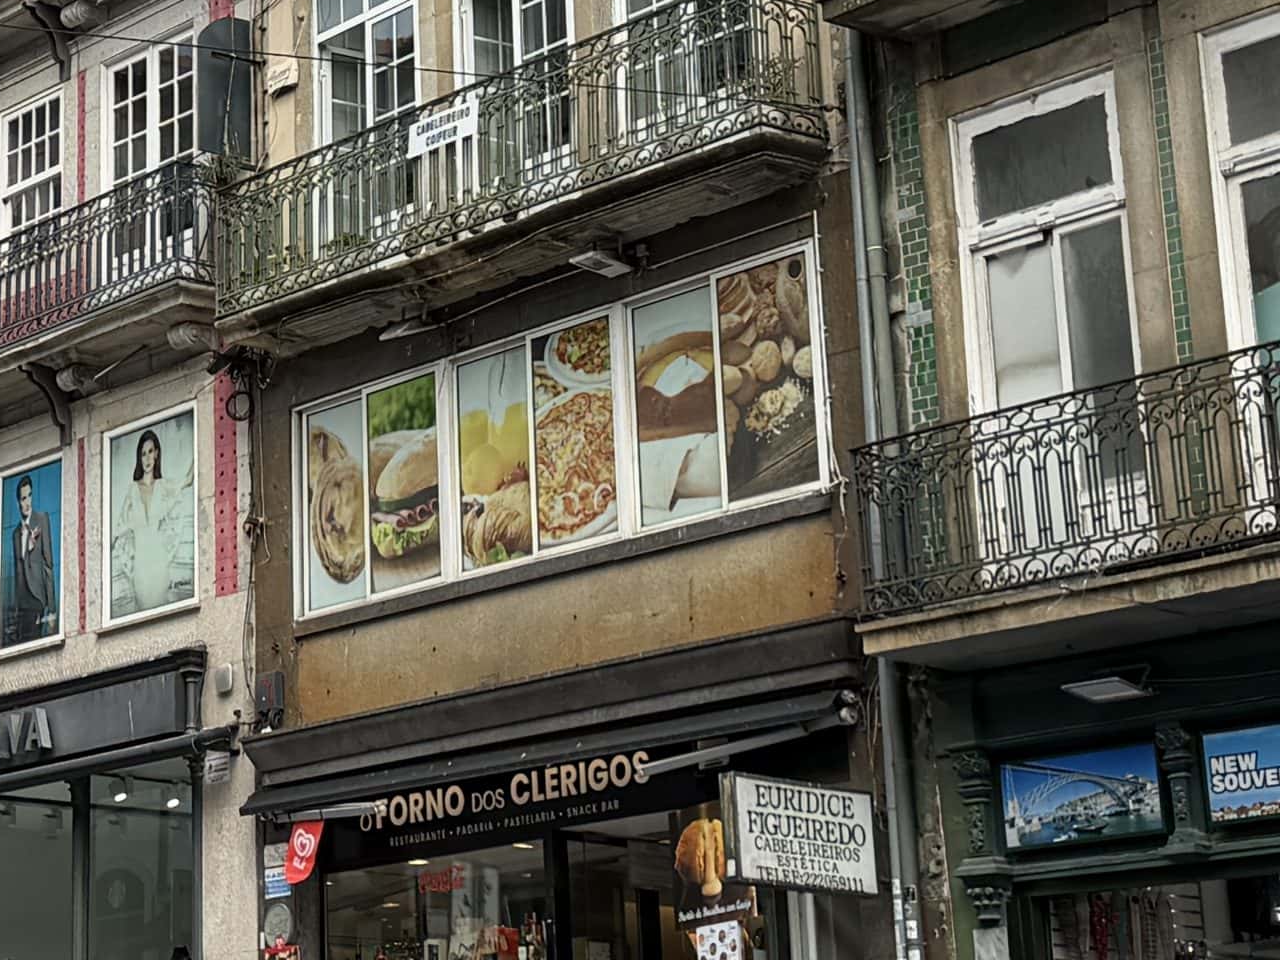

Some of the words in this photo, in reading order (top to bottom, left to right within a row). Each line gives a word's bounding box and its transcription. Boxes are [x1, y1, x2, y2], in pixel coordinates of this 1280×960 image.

[1210, 751, 1257, 776] NEW
[1212, 768, 1280, 793] SOUVE
[375, 785, 465, 830] FORNO
[471, 788, 506, 814] DOS
[754, 783, 856, 820] EURIDICE
[389, 828, 447, 848] RESTAURANTE
[455, 820, 494, 836] PADARIA
[503, 810, 557, 829] PASTELARIA
[565, 803, 598, 818] SNACK
[600, 798, 620, 813] BAR
[747, 809, 867, 848] FIGUEIREDO
[754, 835, 862, 863] CABELEIREIROS
